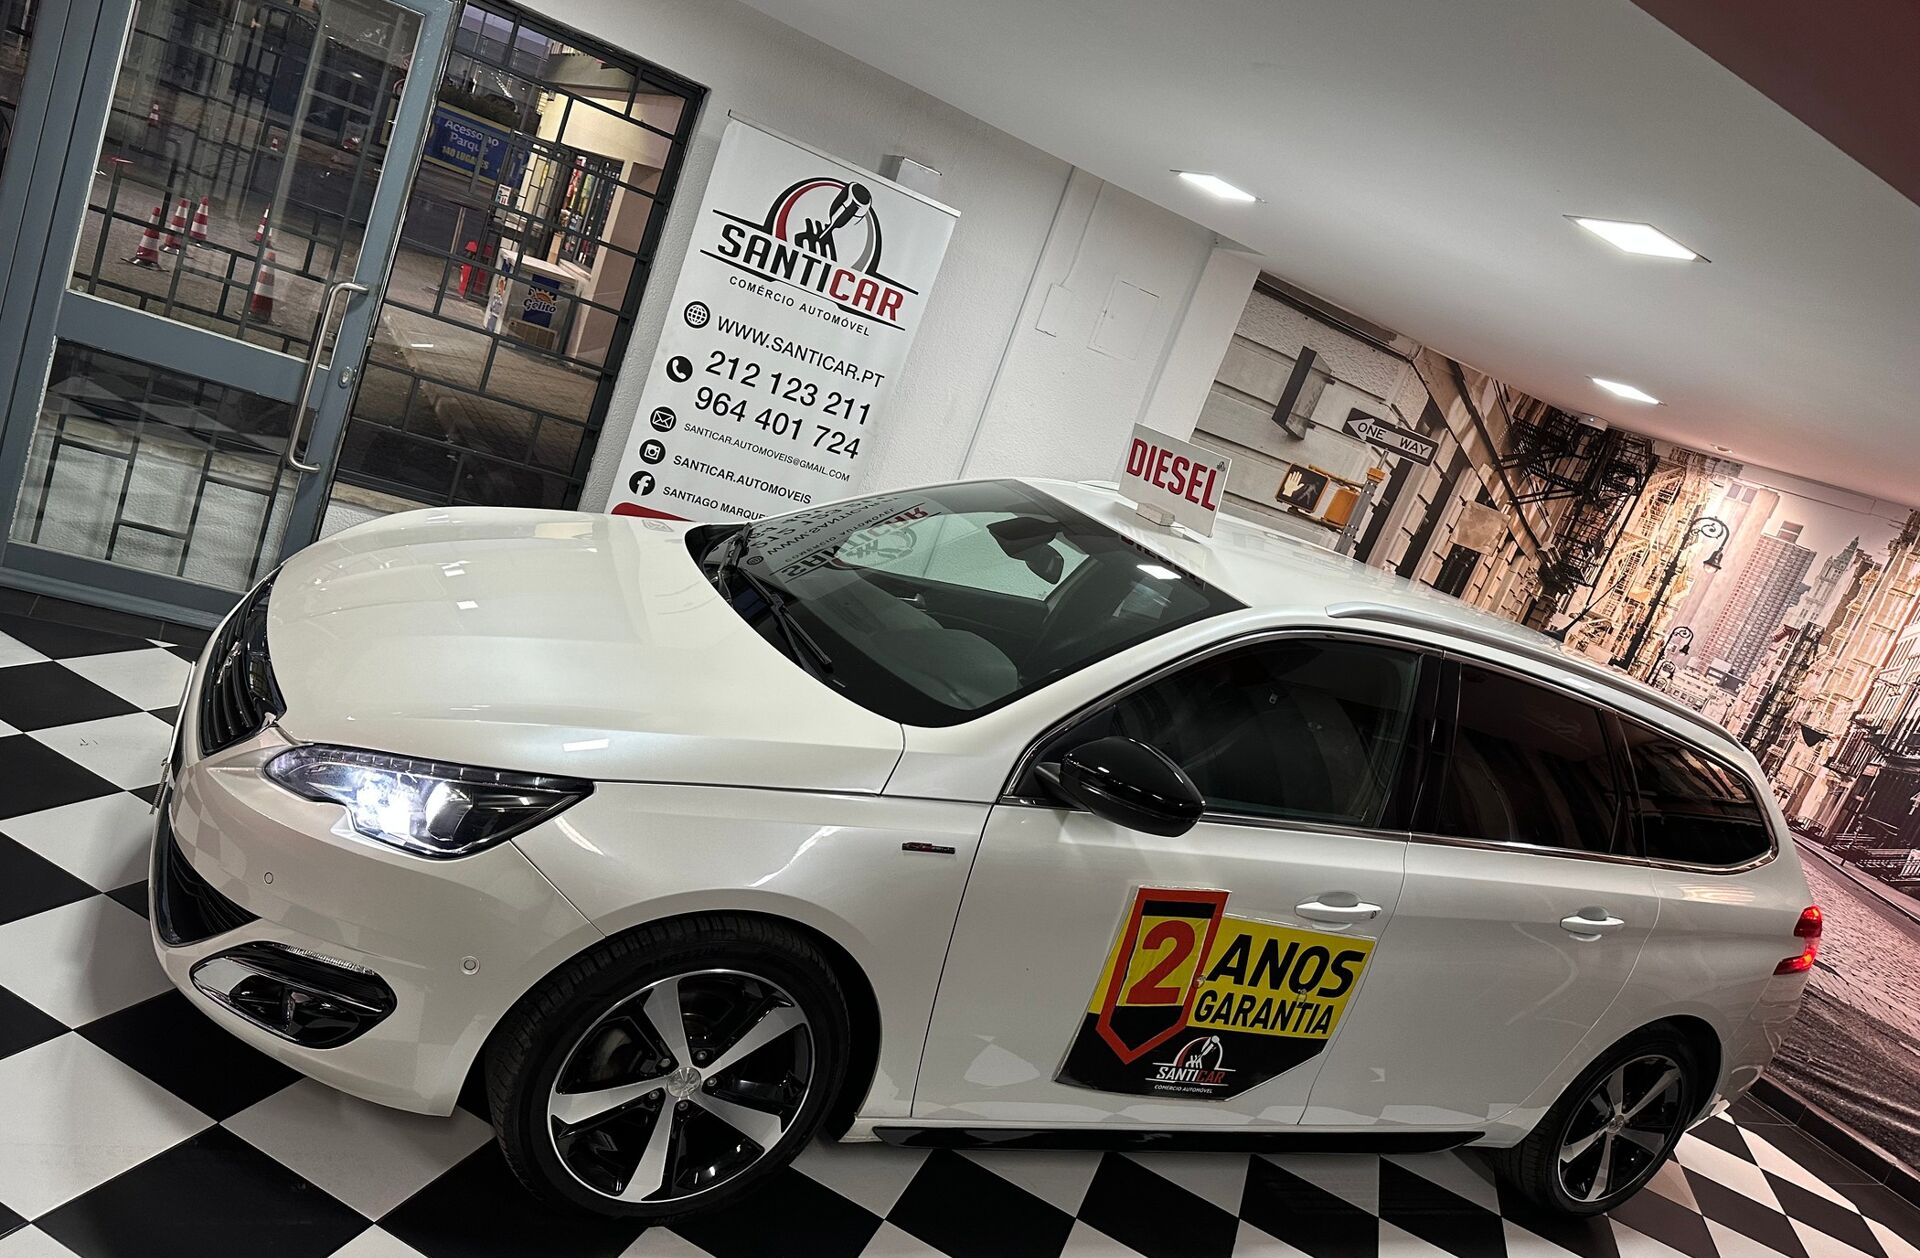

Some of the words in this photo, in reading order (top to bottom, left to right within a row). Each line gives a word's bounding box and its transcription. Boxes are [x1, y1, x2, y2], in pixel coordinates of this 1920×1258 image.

[444, 120, 484, 141] Acesso
[718, 224, 904, 321] SANTICAR
[523, 297, 557, 313] Gelito
[729, 275, 795, 307] COMÉRCIO
[799, 303, 870, 336] AUTOMÓVEL
[717, 315, 885, 388] WWW.SANTICAR.PT
[705, 350, 761, 388] 212
[770, 372, 818, 407] 123
[823, 392, 871, 425] 211
[695, 386, 748, 422] 964
[754, 408, 803, 440] 401
[812, 424, 861, 459] 724
[1357, 422, 1387, 440] ONE
[1400, 437, 1429, 455] WAY
[673, 455, 812, 504] SANTICAR.AUTOMOVEIS
[683, 423, 850, 482] SANTICAR.AUTOMOVEIS@GMAIL.COM
[1125, 437, 1217, 512] DIESEL
[662, 486, 719, 509] SANTIAGO
[1125, 919, 1196, 1005] 2
[1205, 933, 1367, 998] ANOS
[1193, 989, 1336, 1035] GARANTIA
[1156, 1066, 1226, 1084] SANTICAR
